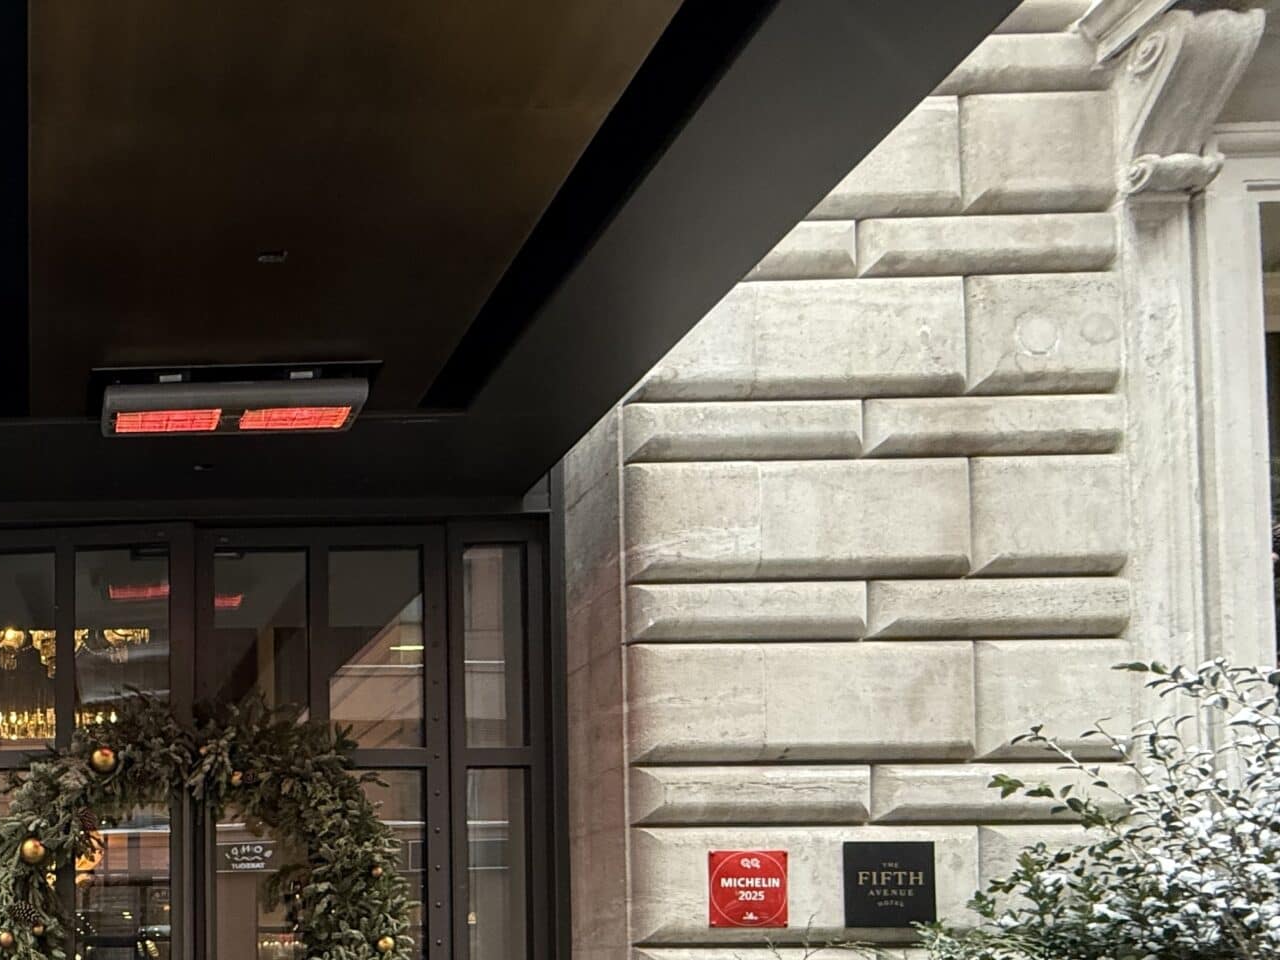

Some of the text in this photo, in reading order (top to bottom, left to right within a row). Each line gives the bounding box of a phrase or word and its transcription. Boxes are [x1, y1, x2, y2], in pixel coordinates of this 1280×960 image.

[720, 877, 780, 888] MICHELIN
[857, 871, 924, 886] FIFTH
[738, 890, 765, 901] 2025
[867, 889, 914, 897] AVENUE
